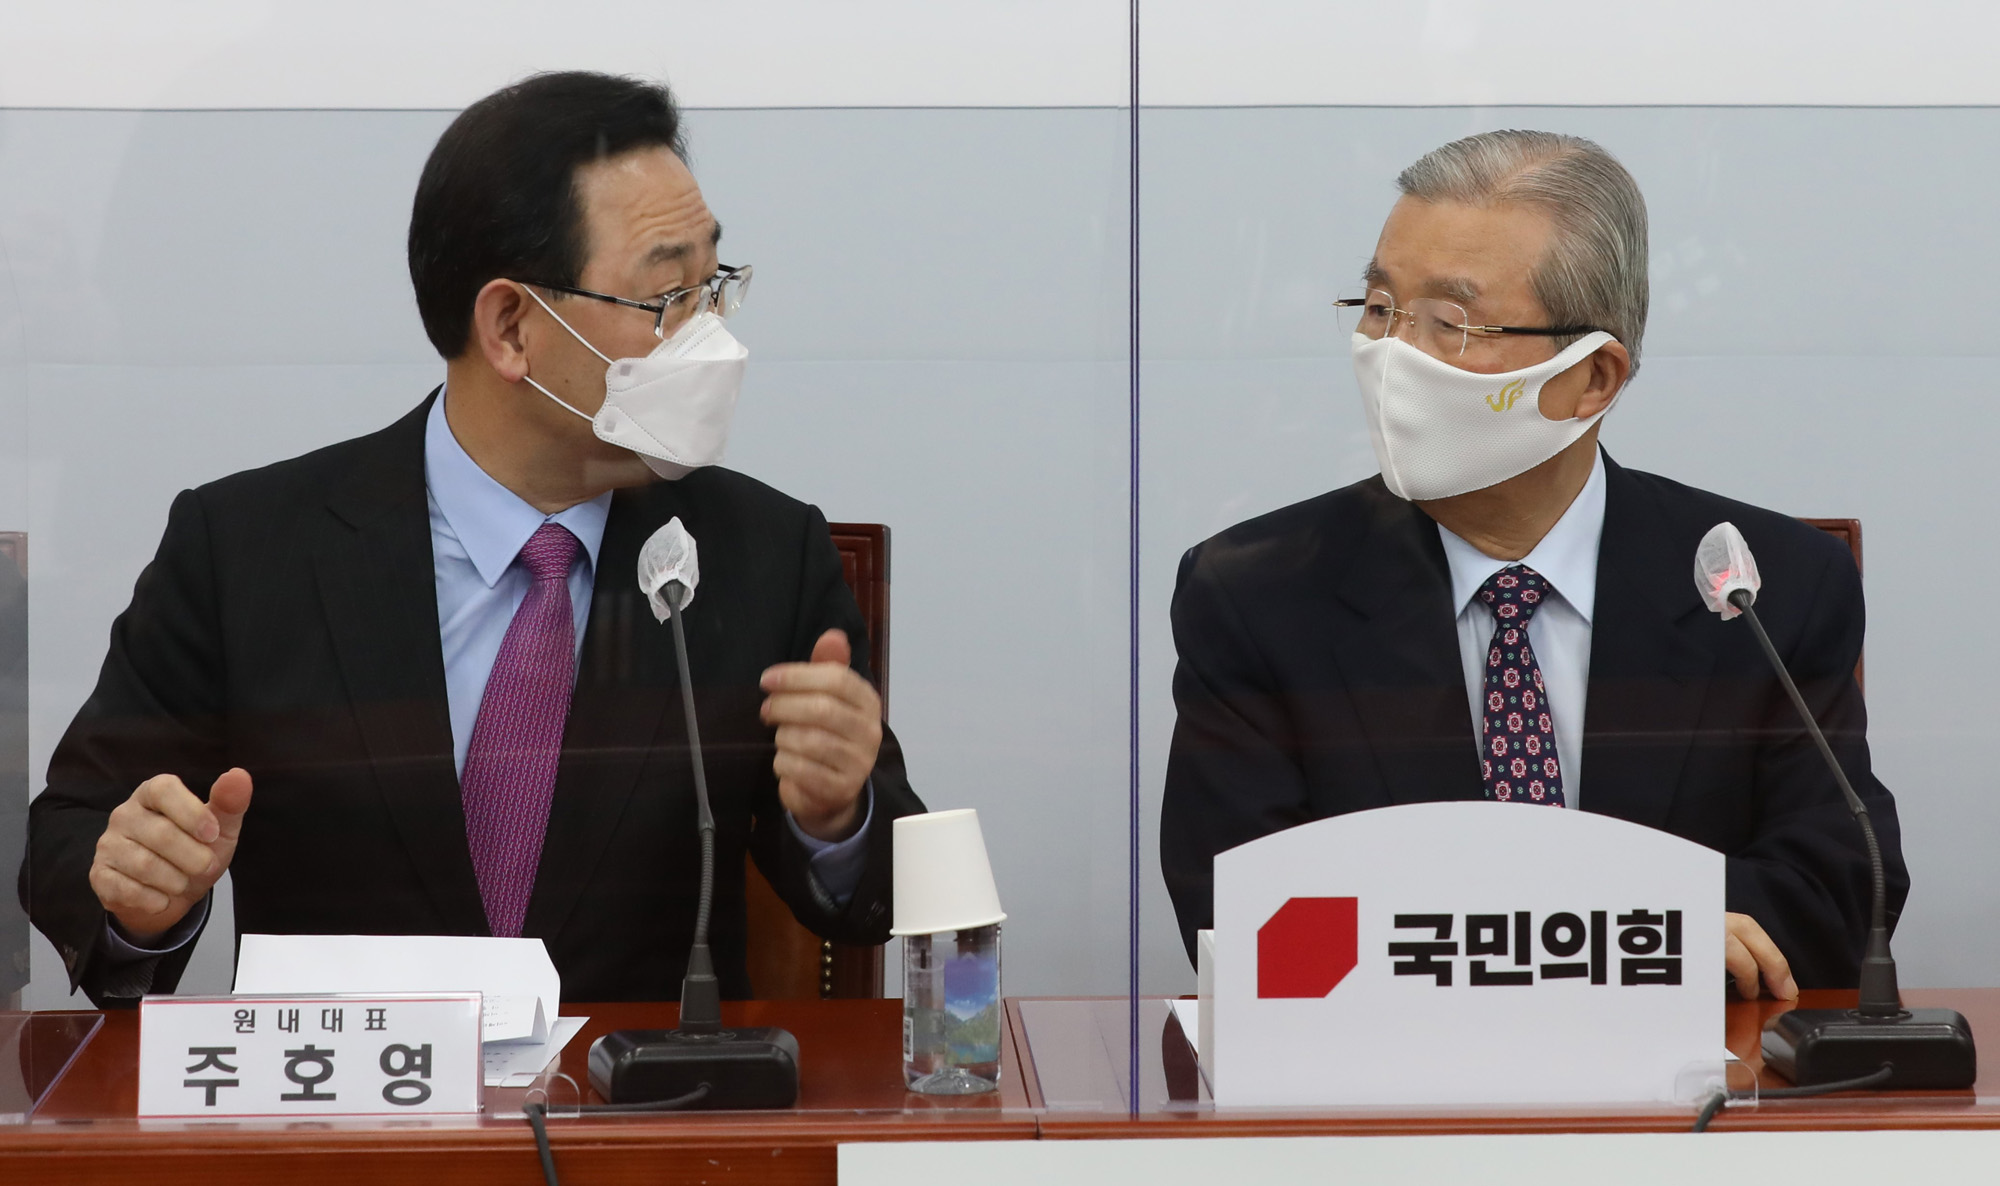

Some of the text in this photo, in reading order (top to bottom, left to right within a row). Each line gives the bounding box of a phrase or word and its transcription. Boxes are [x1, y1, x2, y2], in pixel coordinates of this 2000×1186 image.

[1388, 909, 1683, 987] 국민의힘
[233, 1008, 387, 1034] 원내대표
[183, 1043, 433, 1107] 주호영
